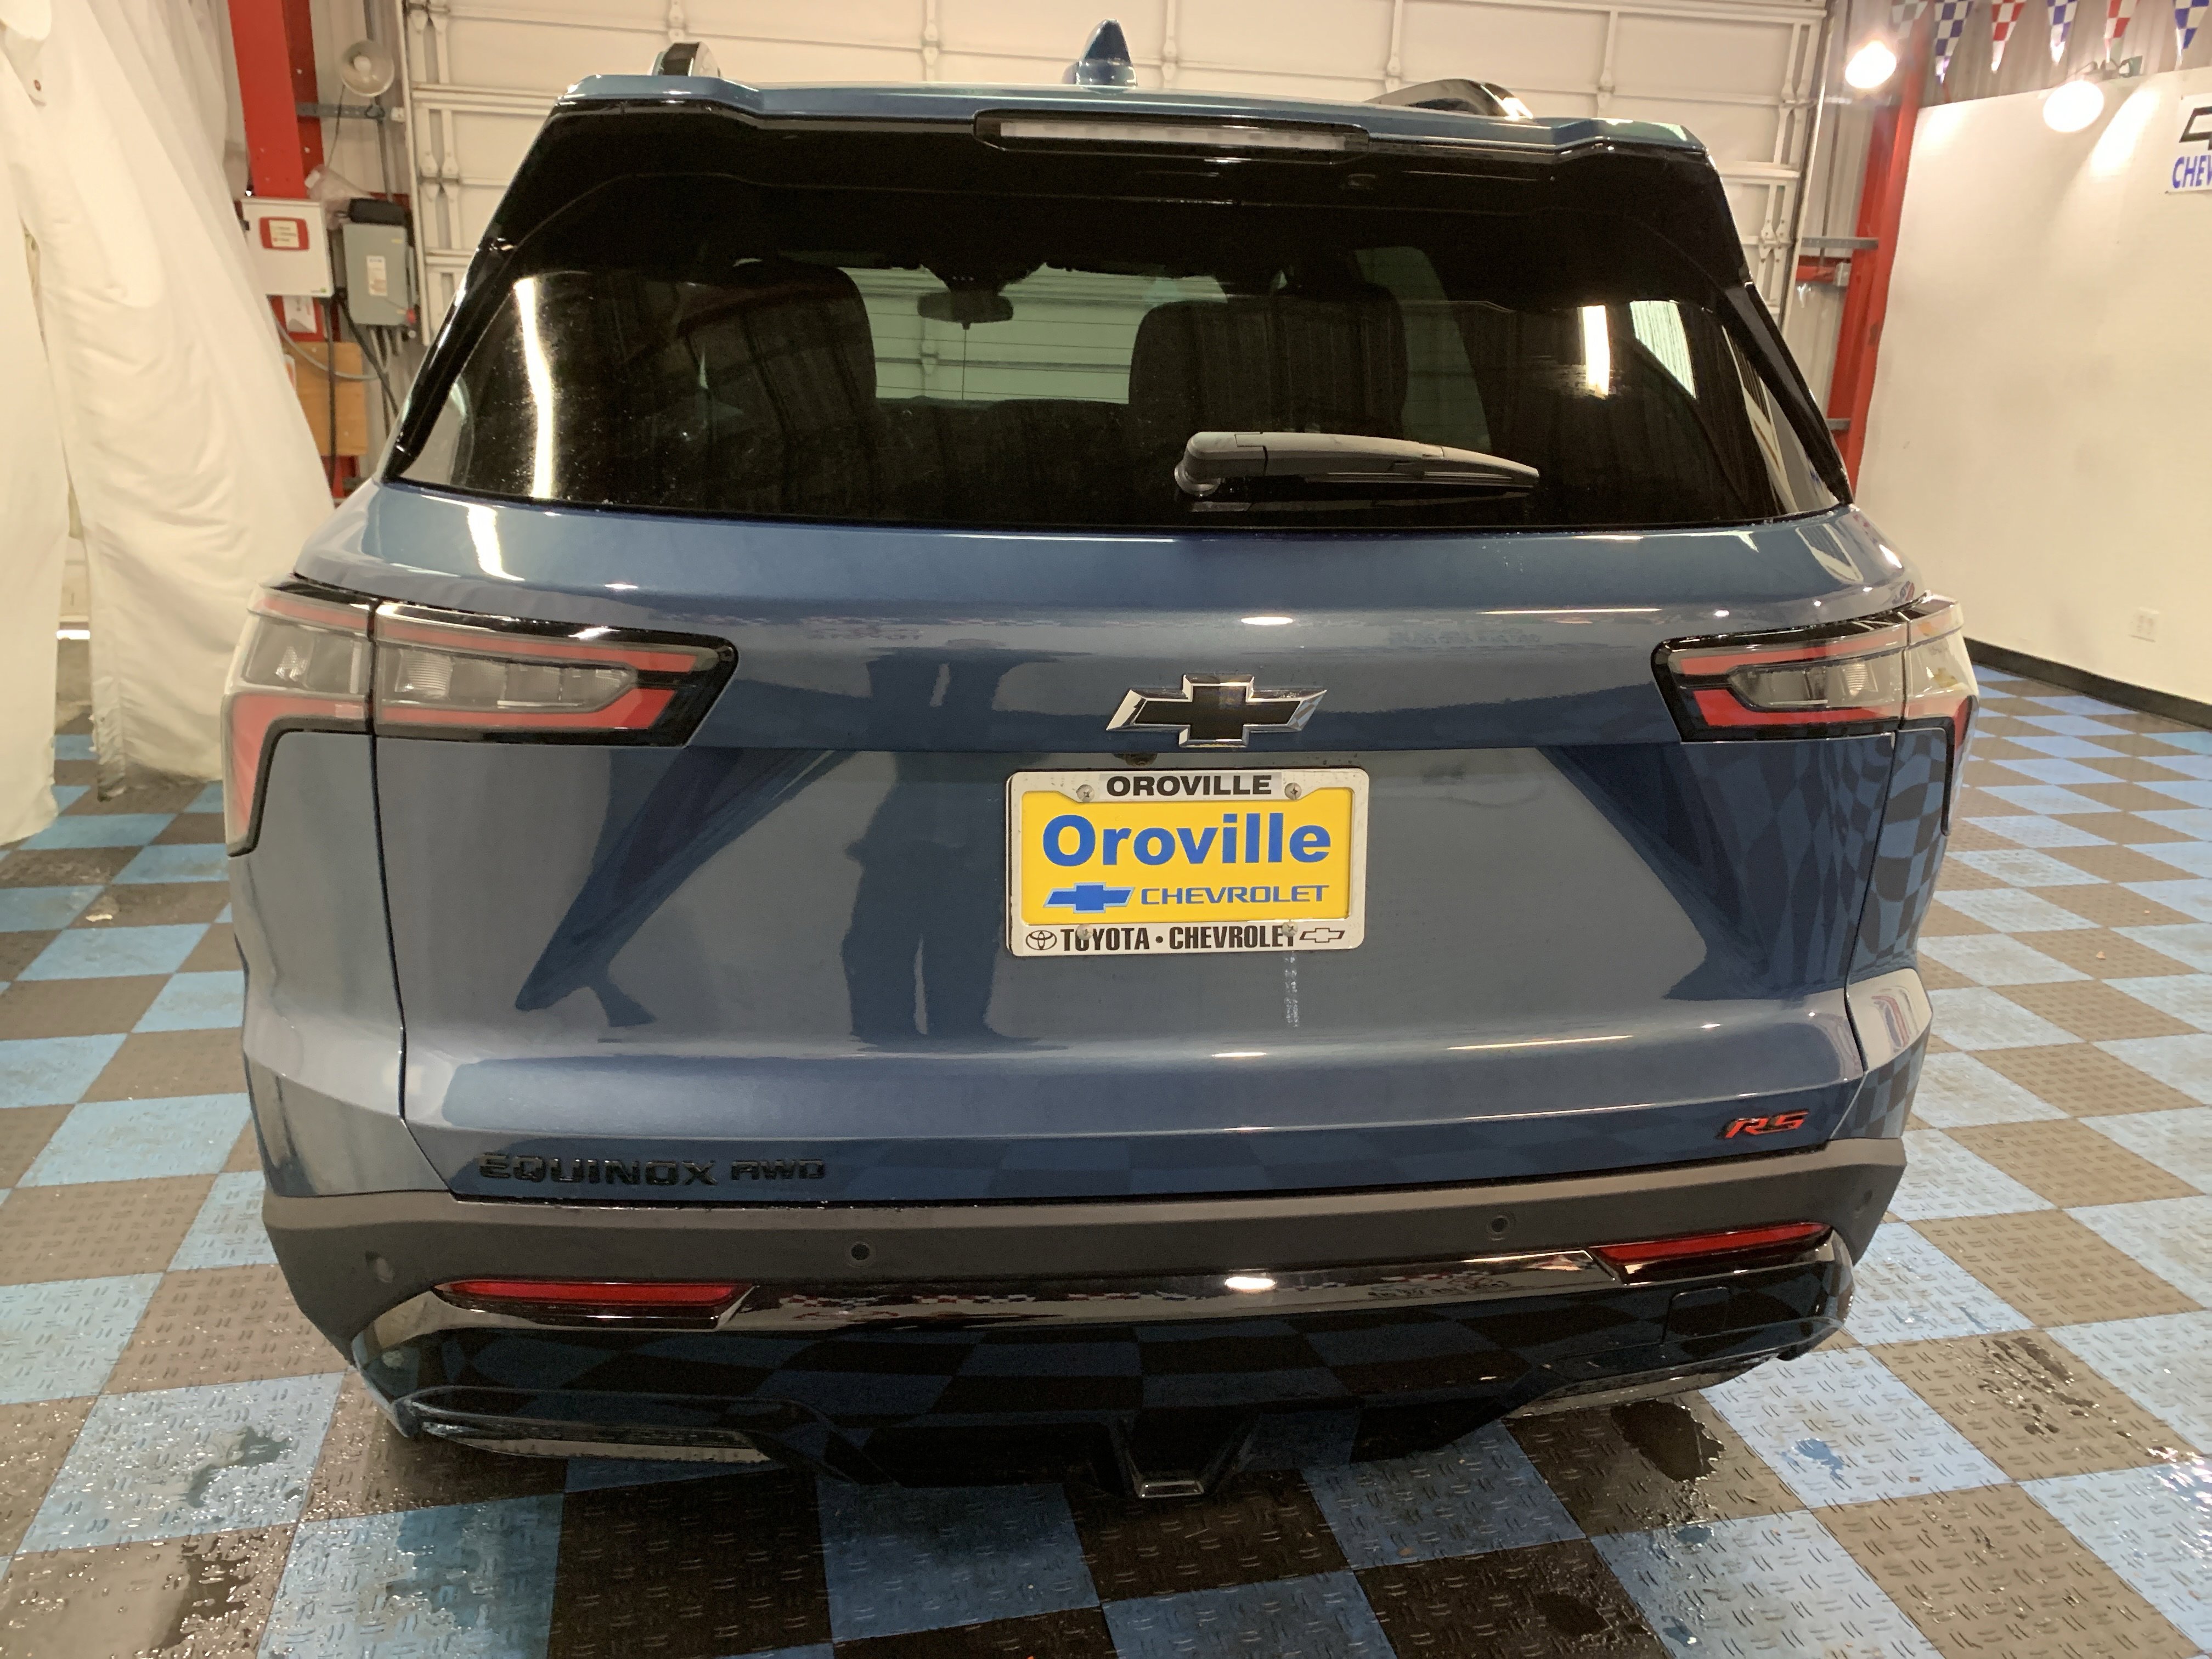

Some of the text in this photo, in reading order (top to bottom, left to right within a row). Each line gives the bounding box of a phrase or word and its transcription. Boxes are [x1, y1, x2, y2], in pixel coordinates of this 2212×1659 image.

[1107, 775, 1272, 796] OROVILLE
[1042, 812, 1331, 866] Oroville
[1141, 885, 1330, 905] CHEVROLET
[1716, 1109, 1809, 1139] RS
[477, 1153, 824, 1186] EQUINOX AWD
